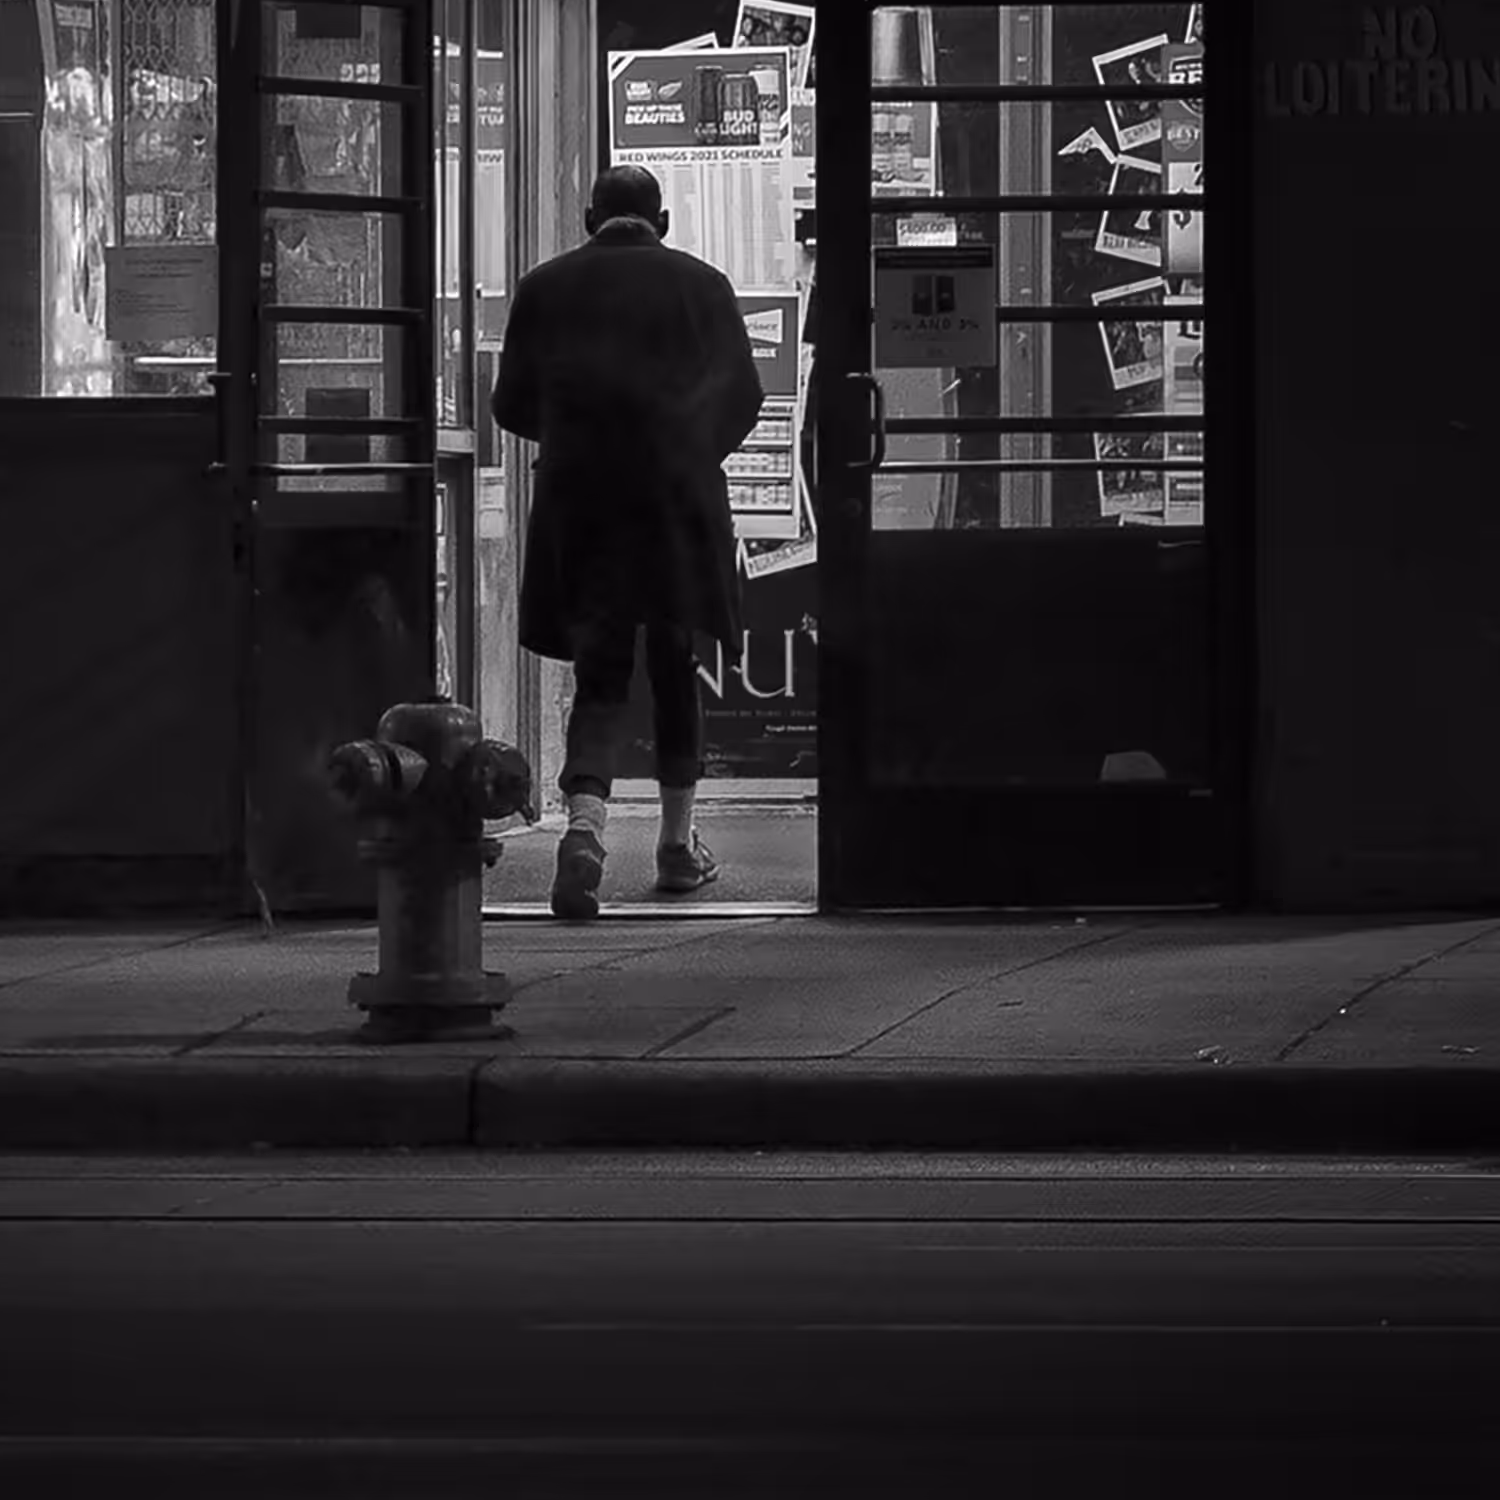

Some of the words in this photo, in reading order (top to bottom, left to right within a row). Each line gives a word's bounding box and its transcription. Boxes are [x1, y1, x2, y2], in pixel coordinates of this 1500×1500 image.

[1361, 4, 1439, 60] NO
[1264, 58, 1500, 116] LOITERIN
[723, 109, 755, 123] BUD
[719, 122, 758, 136] LIGHT
[618, 151, 645, 163] RED
[646, 151, 688, 162] WINGS
[689, 150, 719, 161] 2021
[721, 148, 784, 160] SCHEDULE
